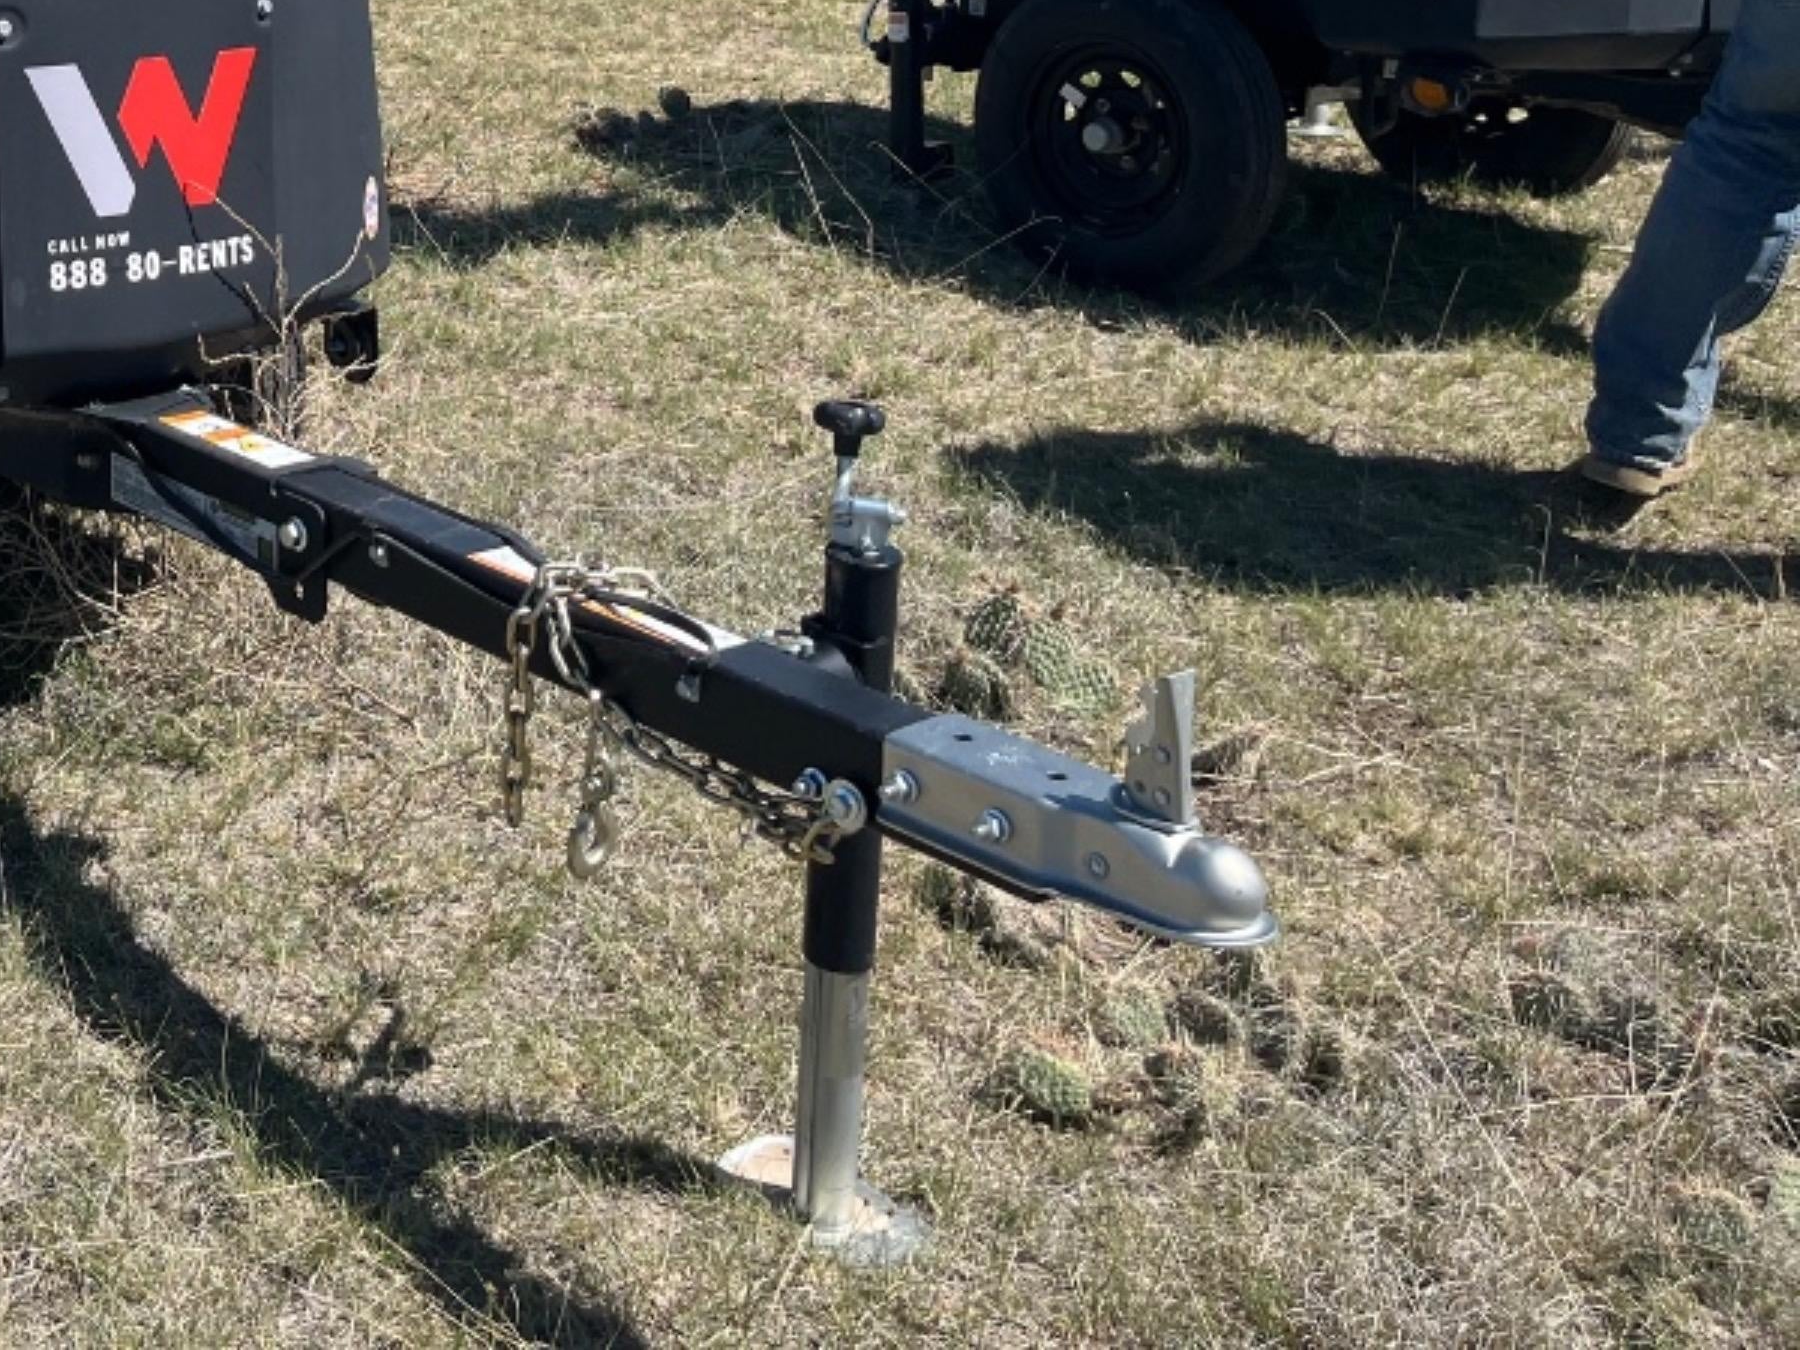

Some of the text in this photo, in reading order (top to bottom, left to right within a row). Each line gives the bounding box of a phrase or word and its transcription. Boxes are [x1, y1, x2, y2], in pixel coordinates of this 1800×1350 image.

[47, 231, 130, 256] CALL NOW
[49, 234, 255, 292] 888 80-RENTS
